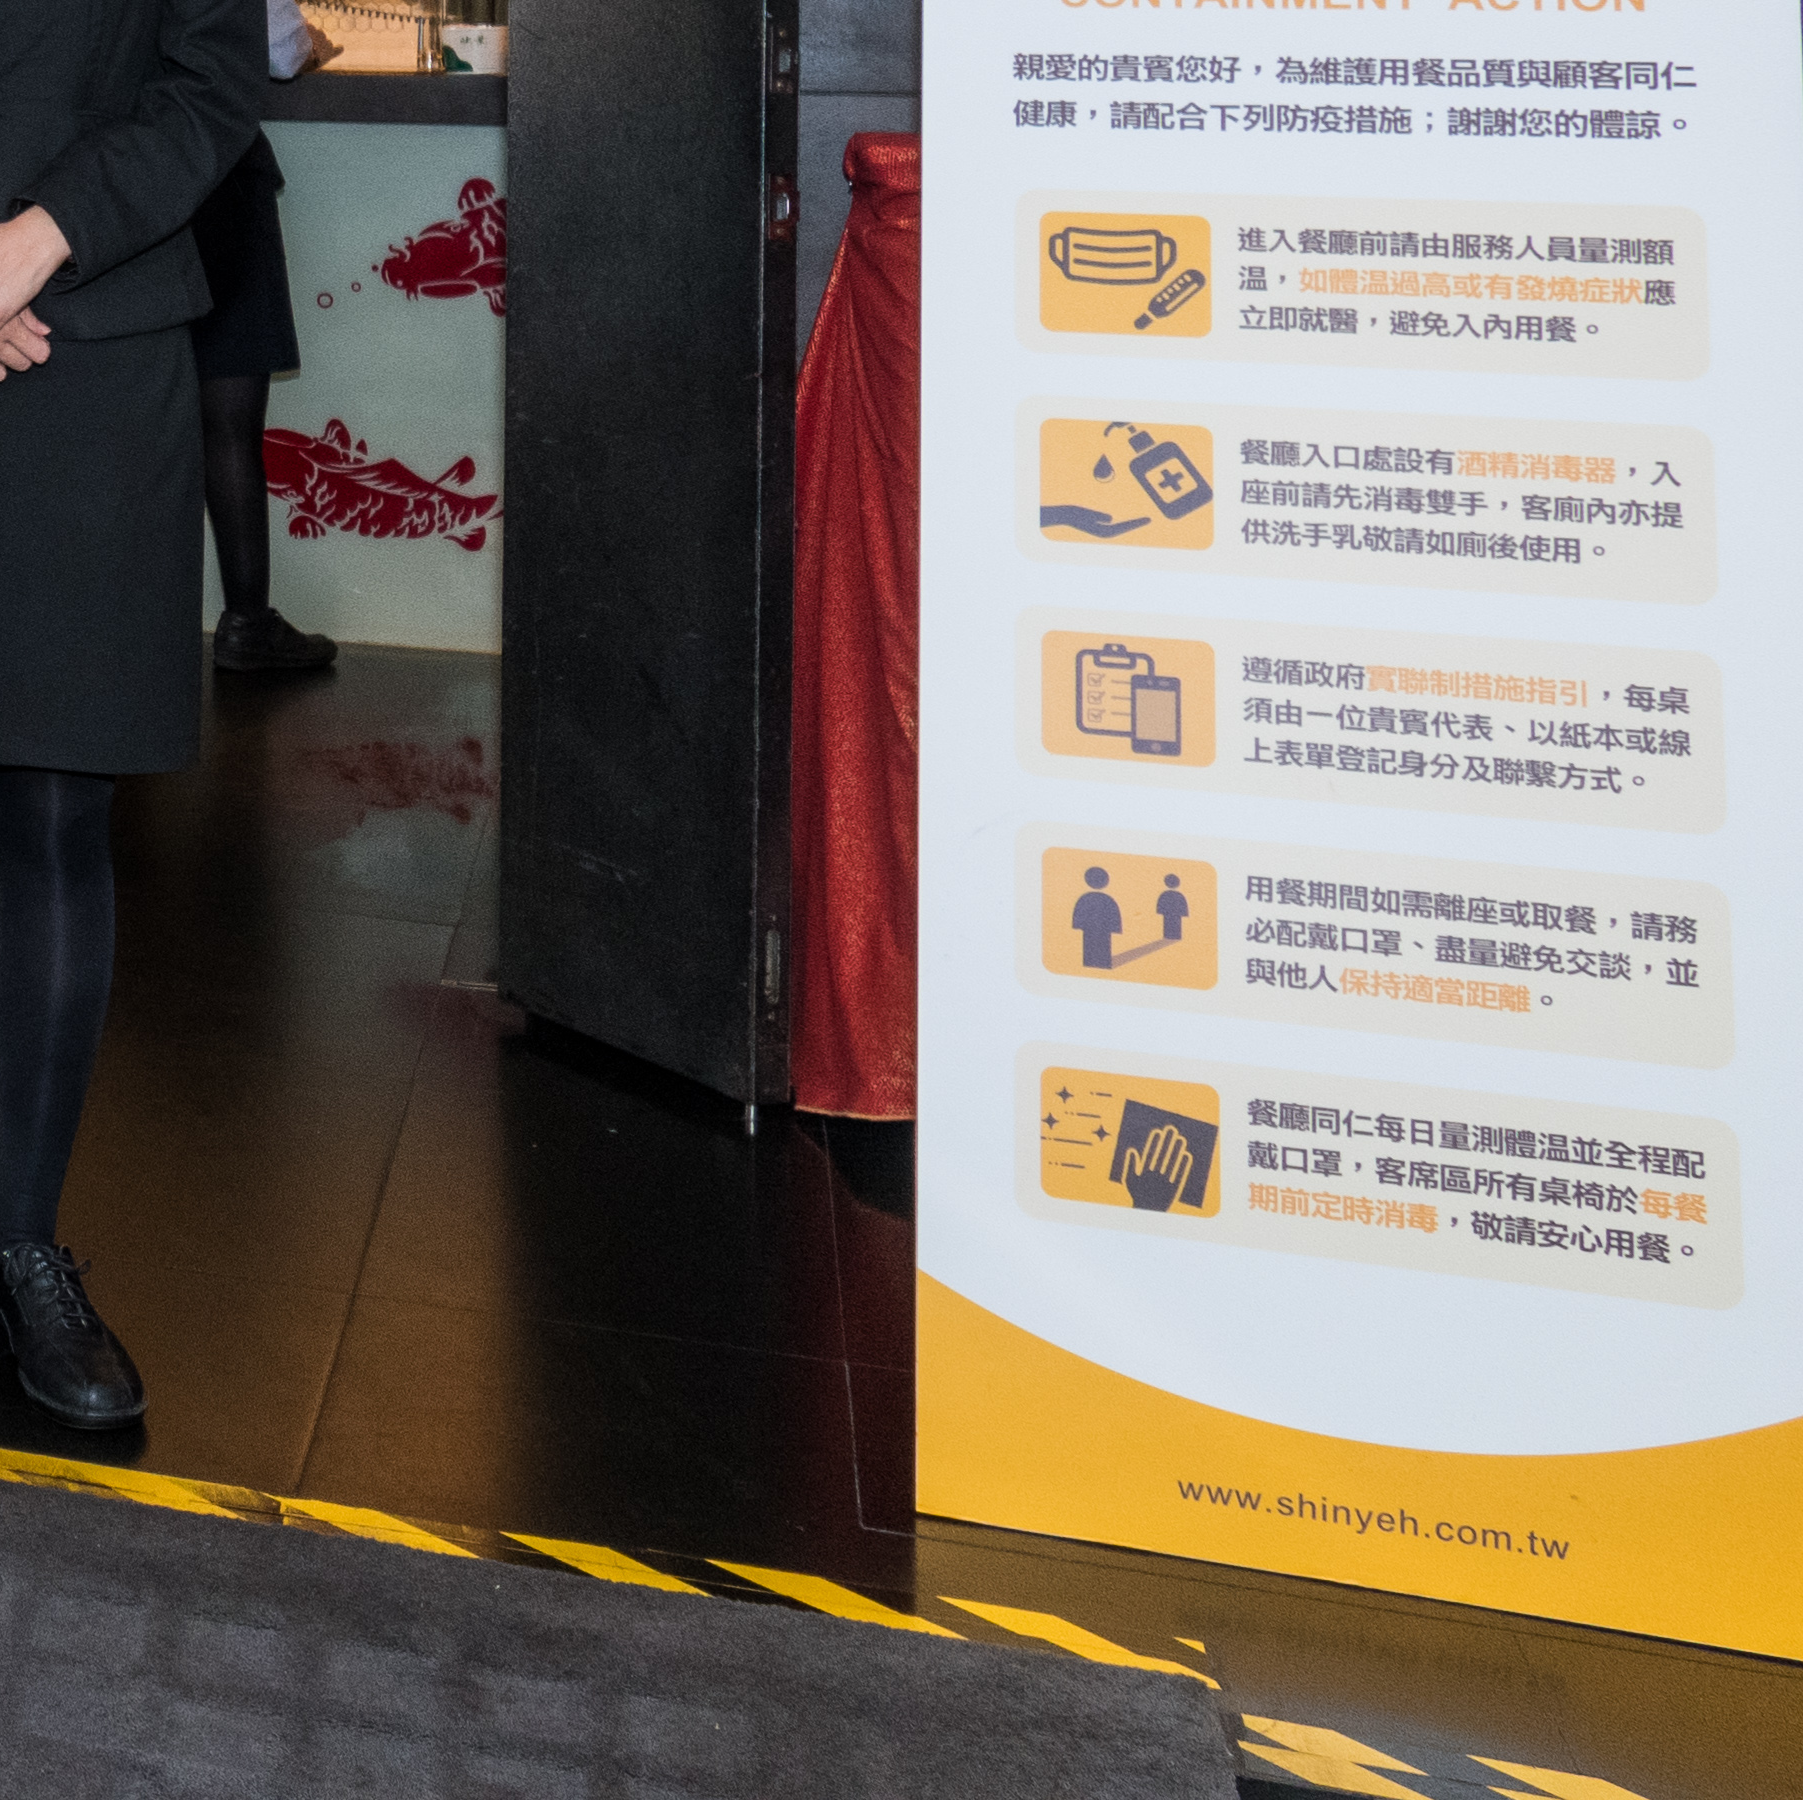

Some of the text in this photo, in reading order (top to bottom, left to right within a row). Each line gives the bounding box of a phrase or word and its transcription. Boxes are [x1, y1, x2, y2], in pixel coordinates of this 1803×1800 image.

[1013, 52, 1697, 90] 親愛的貴賓您好，為維護用餐品質與顧客同仁
[1238, 227, 1674, 265] 進入餐廳前請由服務人員量測額
[1240, 439, 1681, 487] 餐廳入口處設有酒精消毒器，入
[1242, 656, 1691, 715] 遵循政府實聯制措施指引，每桌
[1245, 875, 1698, 945] 用餐期間如需離座或取餐，請務
[1177, 1480, 1570, 1561] www.shinyeh.com.tw
